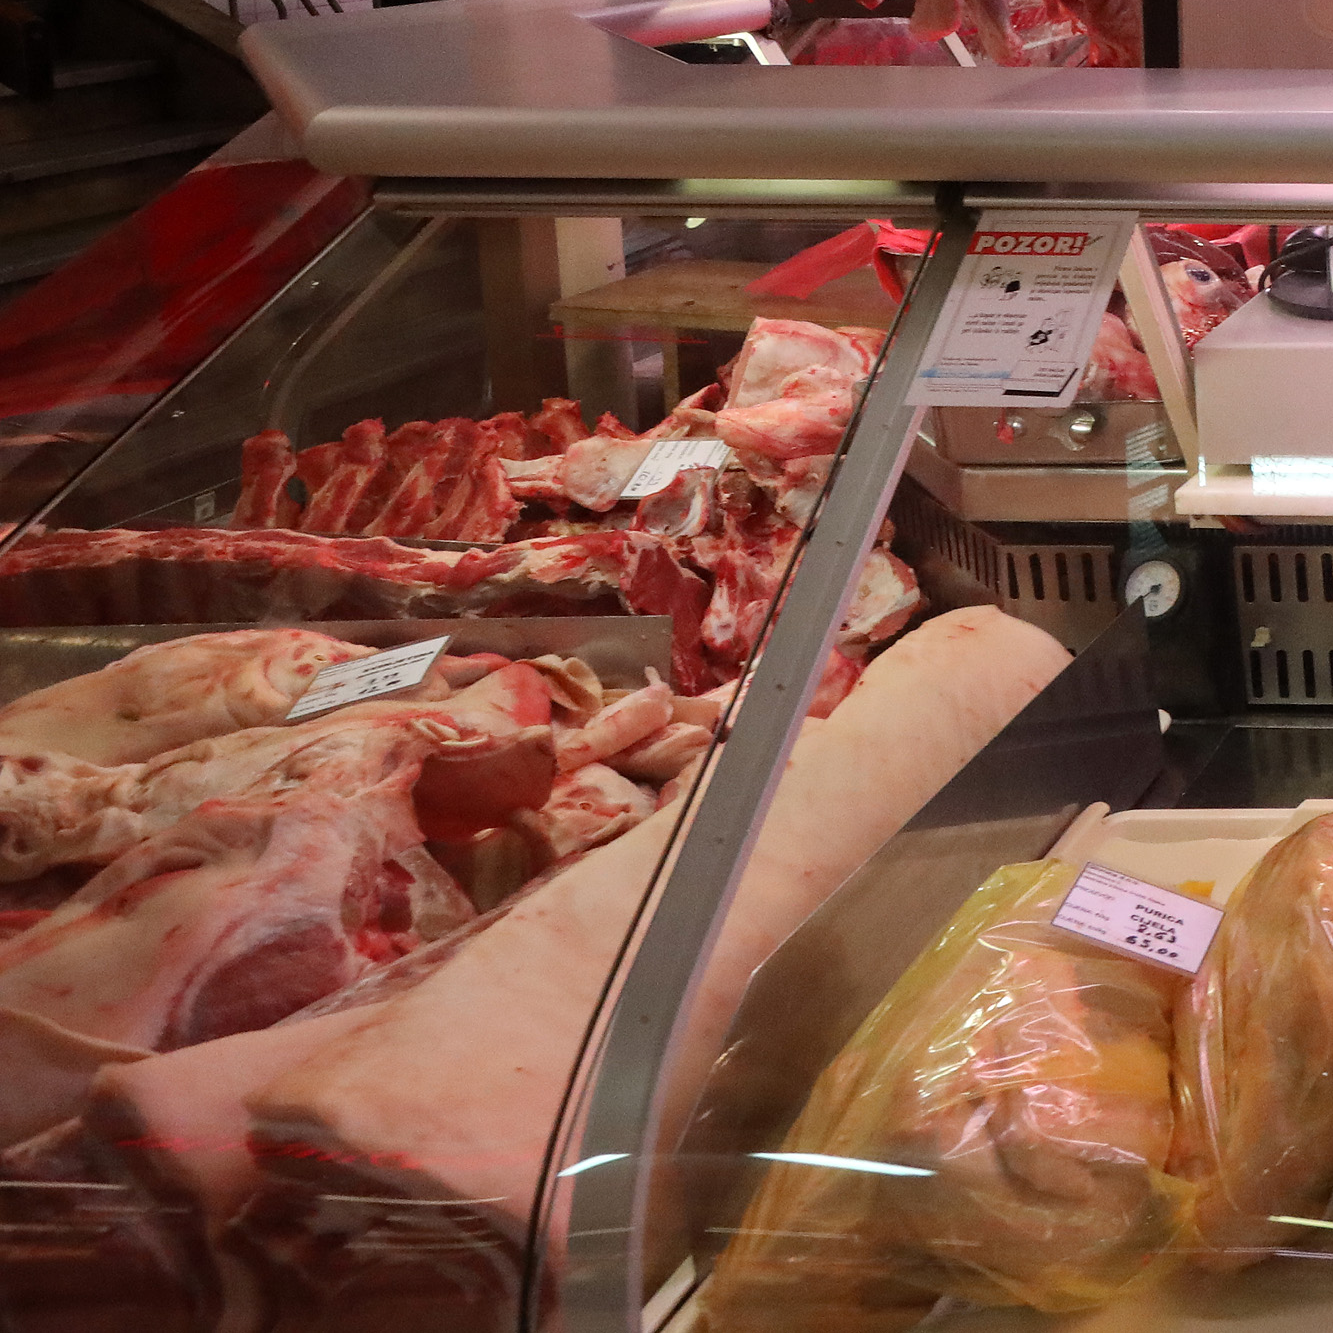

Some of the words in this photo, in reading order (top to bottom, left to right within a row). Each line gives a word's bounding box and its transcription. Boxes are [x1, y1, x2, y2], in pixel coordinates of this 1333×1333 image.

[974, 234, 1084, 254] POZOR!
[1129, 914, 1177, 934] CIJELA
[1135, 903, 1184, 926] PURICA
